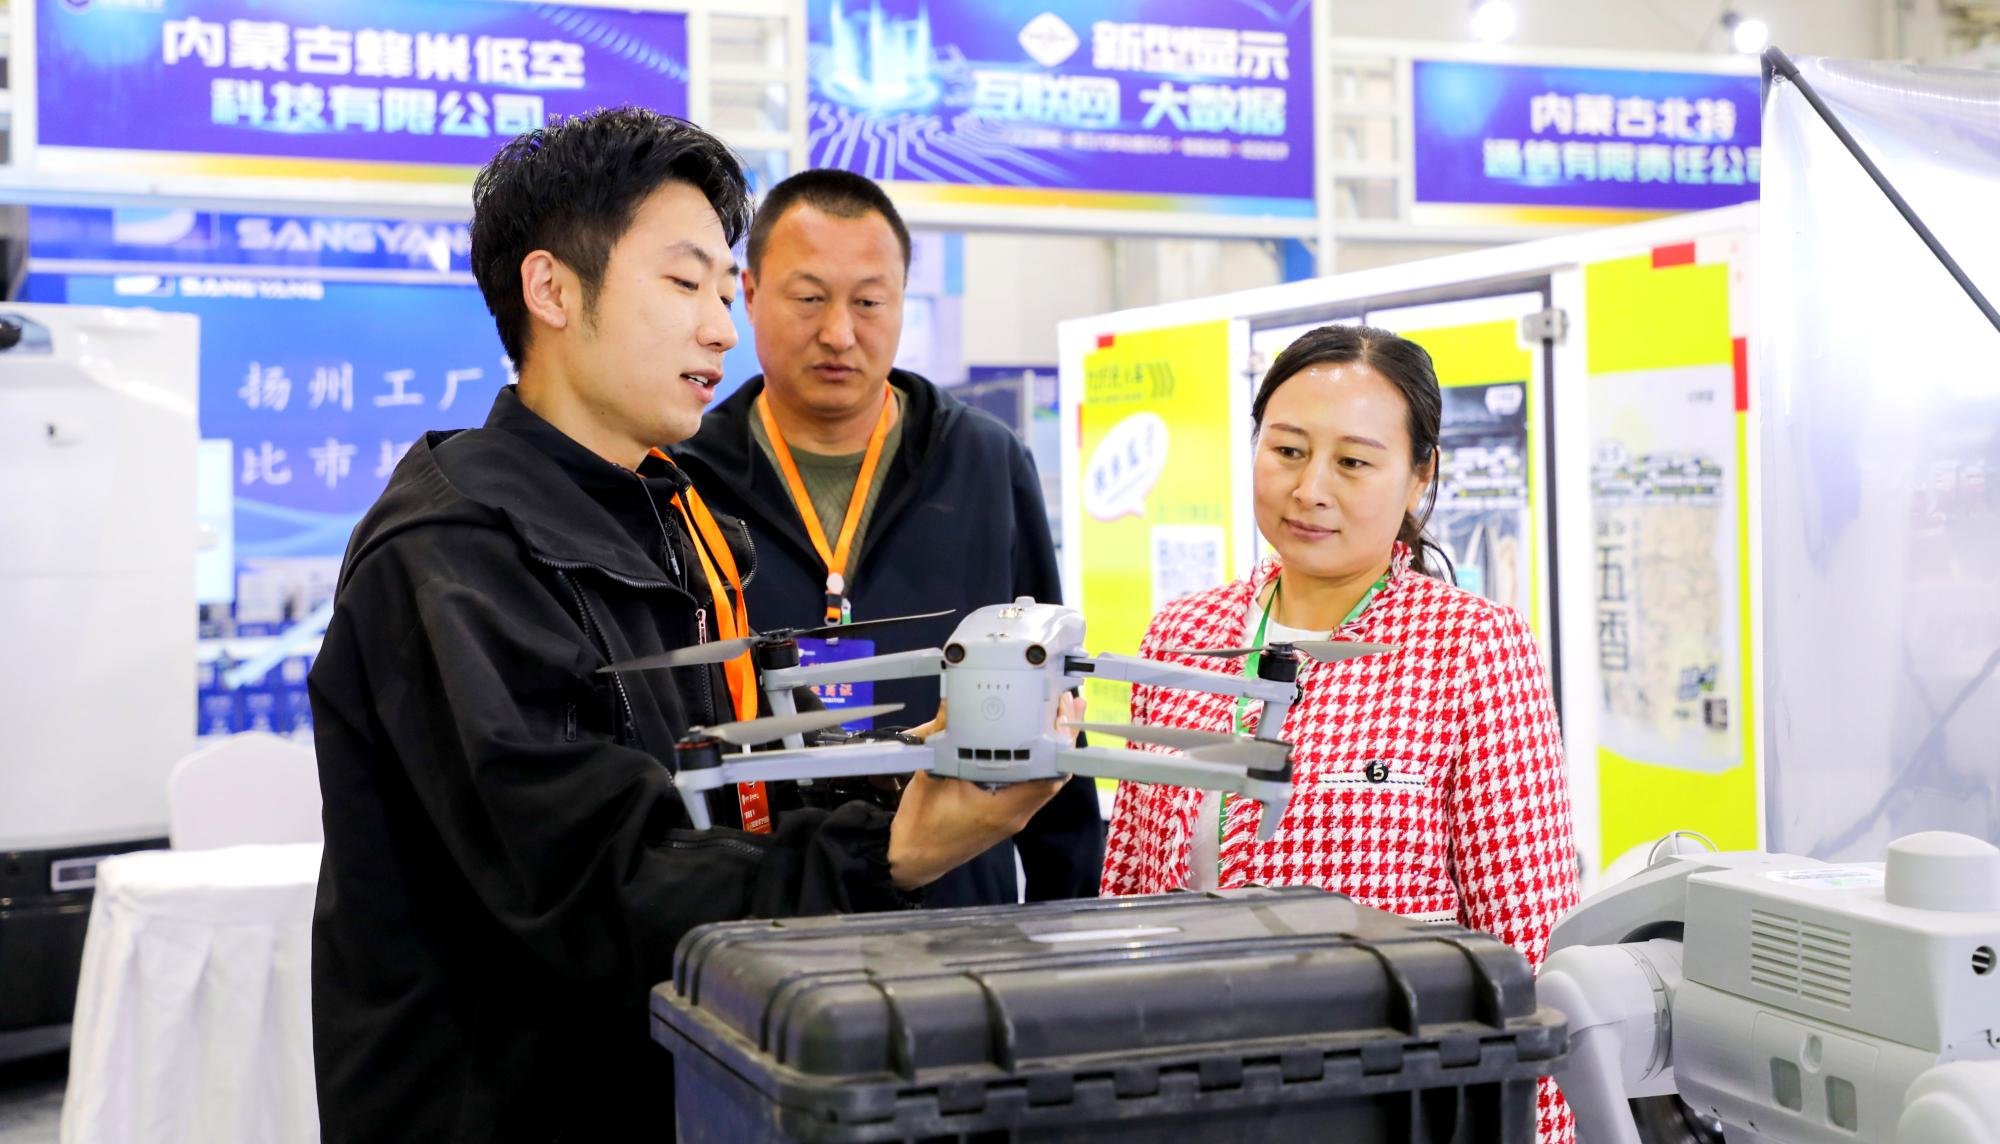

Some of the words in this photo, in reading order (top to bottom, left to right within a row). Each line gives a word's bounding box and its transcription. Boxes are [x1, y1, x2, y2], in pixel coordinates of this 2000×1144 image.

[162, 16, 587, 90] 内蒙古蜂巢低空
[1092, 19, 1290, 82] 新型显示
[210, 77, 545, 138] 科技有限公司
[971, 69, 1121, 128] 互联网
[1138, 81, 1288, 137] 大数据
[1530, 92, 1737, 141] 内蒙古北特
[235, 217, 471, 258] SANGYAN
[238, 360, 518, 413] 扬州工厂
[1372, 764, 1385, 781] 5
